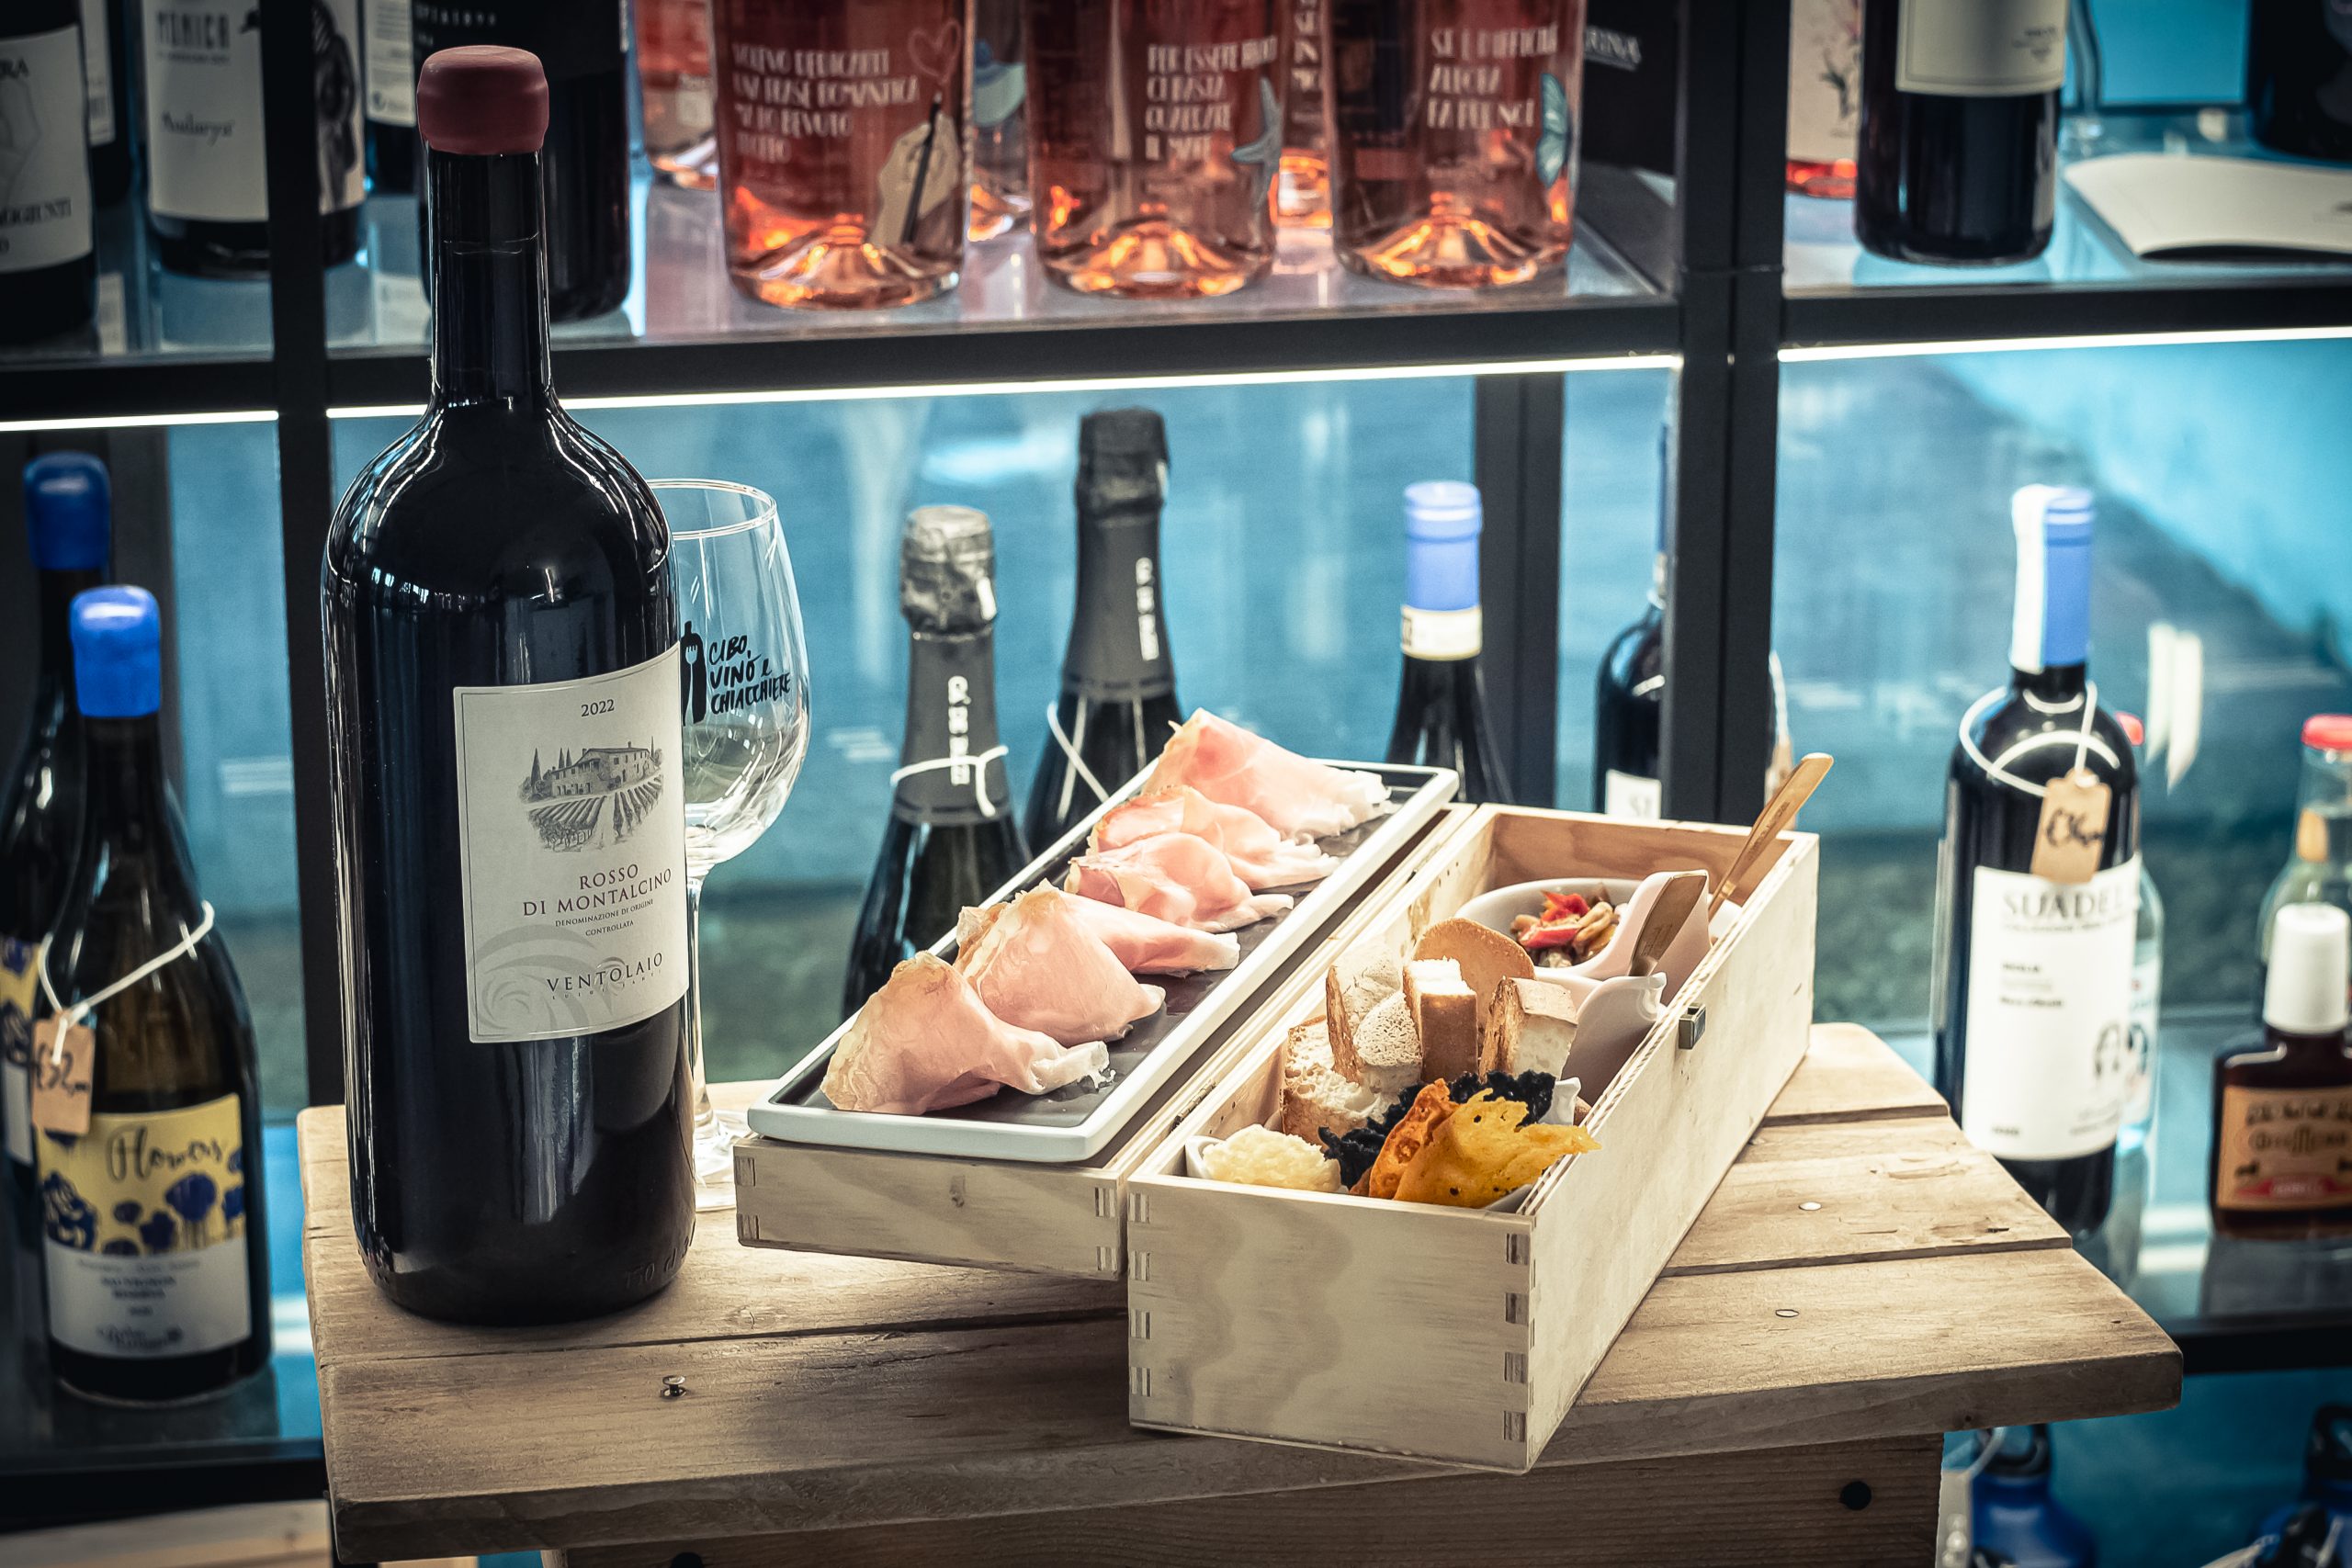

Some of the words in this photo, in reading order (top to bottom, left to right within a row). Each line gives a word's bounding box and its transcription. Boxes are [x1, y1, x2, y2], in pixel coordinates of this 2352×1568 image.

[709, 635, 752, 665] CIBO,
[711, 672, 791, 715] CHIACCHIERE
[581, 699, 615, 717] 2022
[579, 863, 639, 890] ROSSO
[523, 900, 546, 917] DI
[557, 868, 673, 913] MONTALCINO
[555, 910, 619, 928] DENOMINAZIONE
[621, 908, 628, 916] DI
[585, 919, 635, 937] CONTROLLATA
[547, 953, 663, 992] VENTOLAIO
